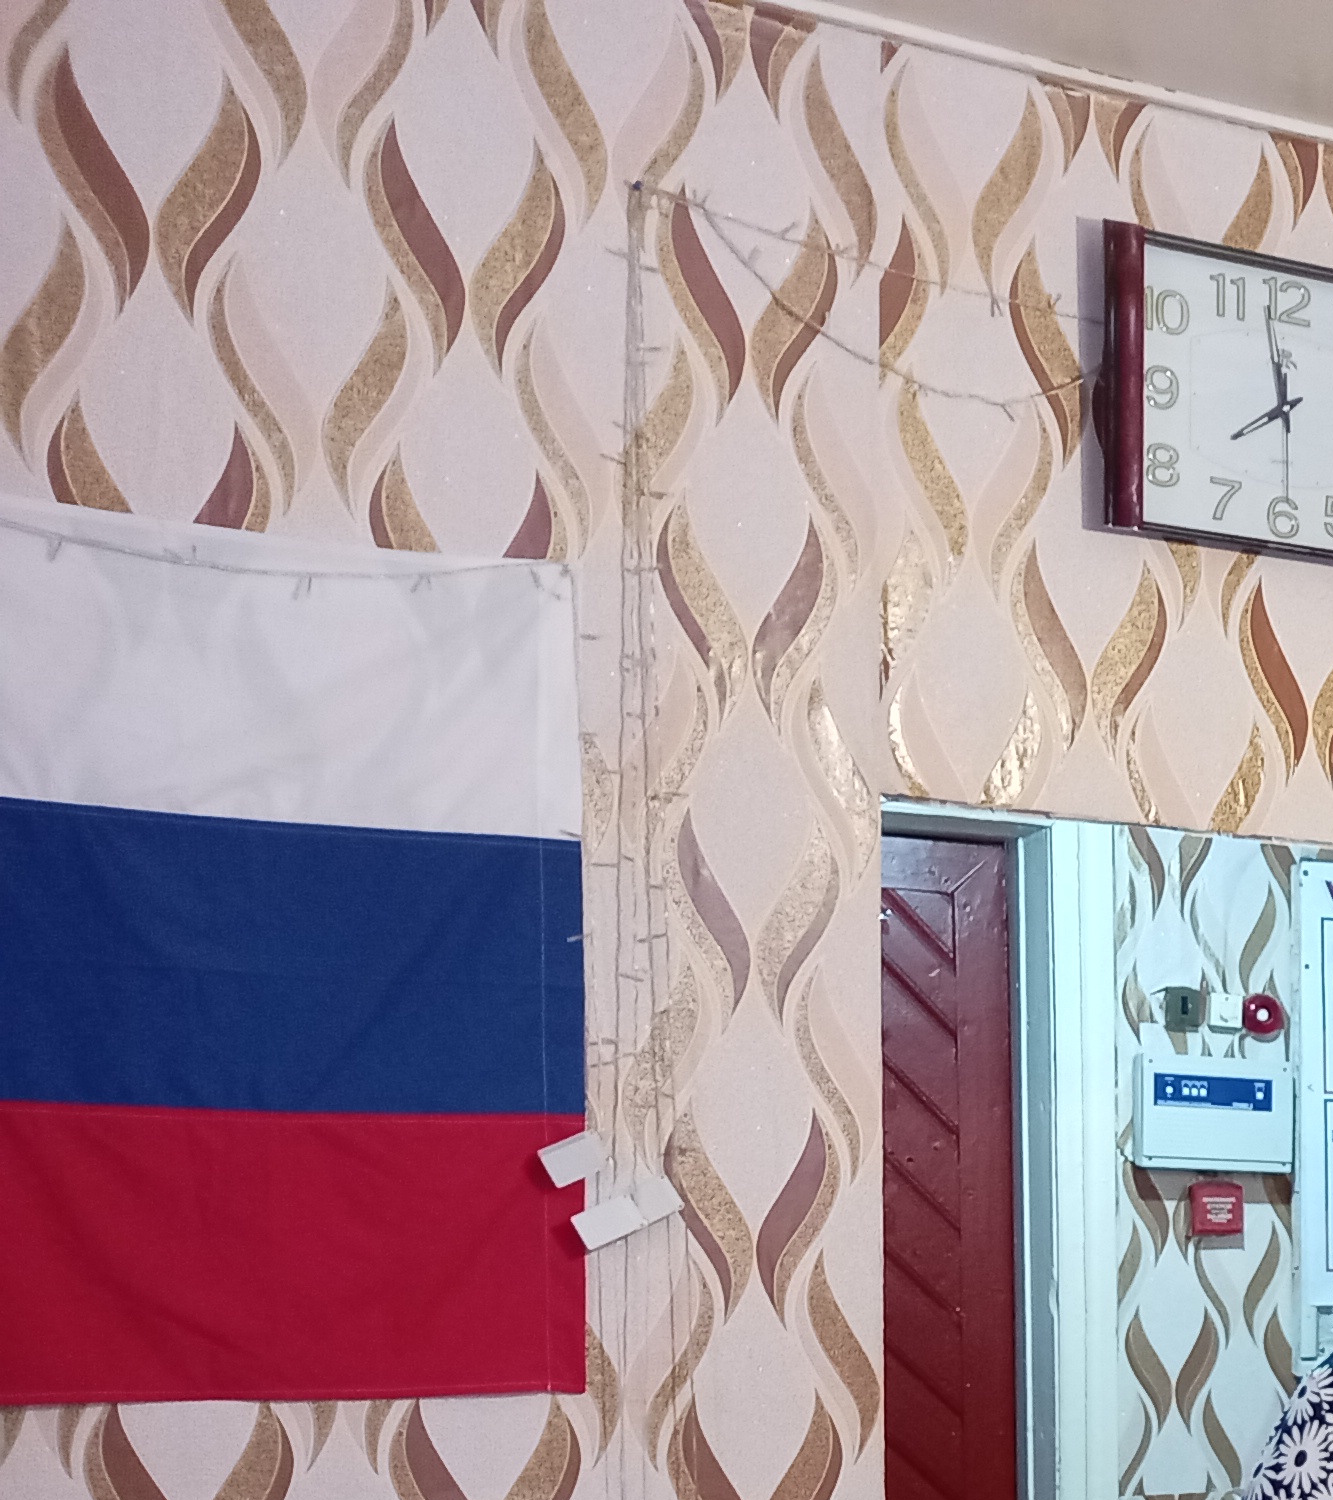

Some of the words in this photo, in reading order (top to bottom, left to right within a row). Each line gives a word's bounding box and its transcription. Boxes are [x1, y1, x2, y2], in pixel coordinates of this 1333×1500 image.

[1145, 286, 1190, 335] 10
[1209, 272, 1246, 321] 11
[1262, 276, 1312, 328] 12
[1145, 365, 1180, 410] 9
[1146, 442, 1180, 487] 8
[1209, 476, 1243, 521] 7
[1266, 496, 1300, 538] 6
